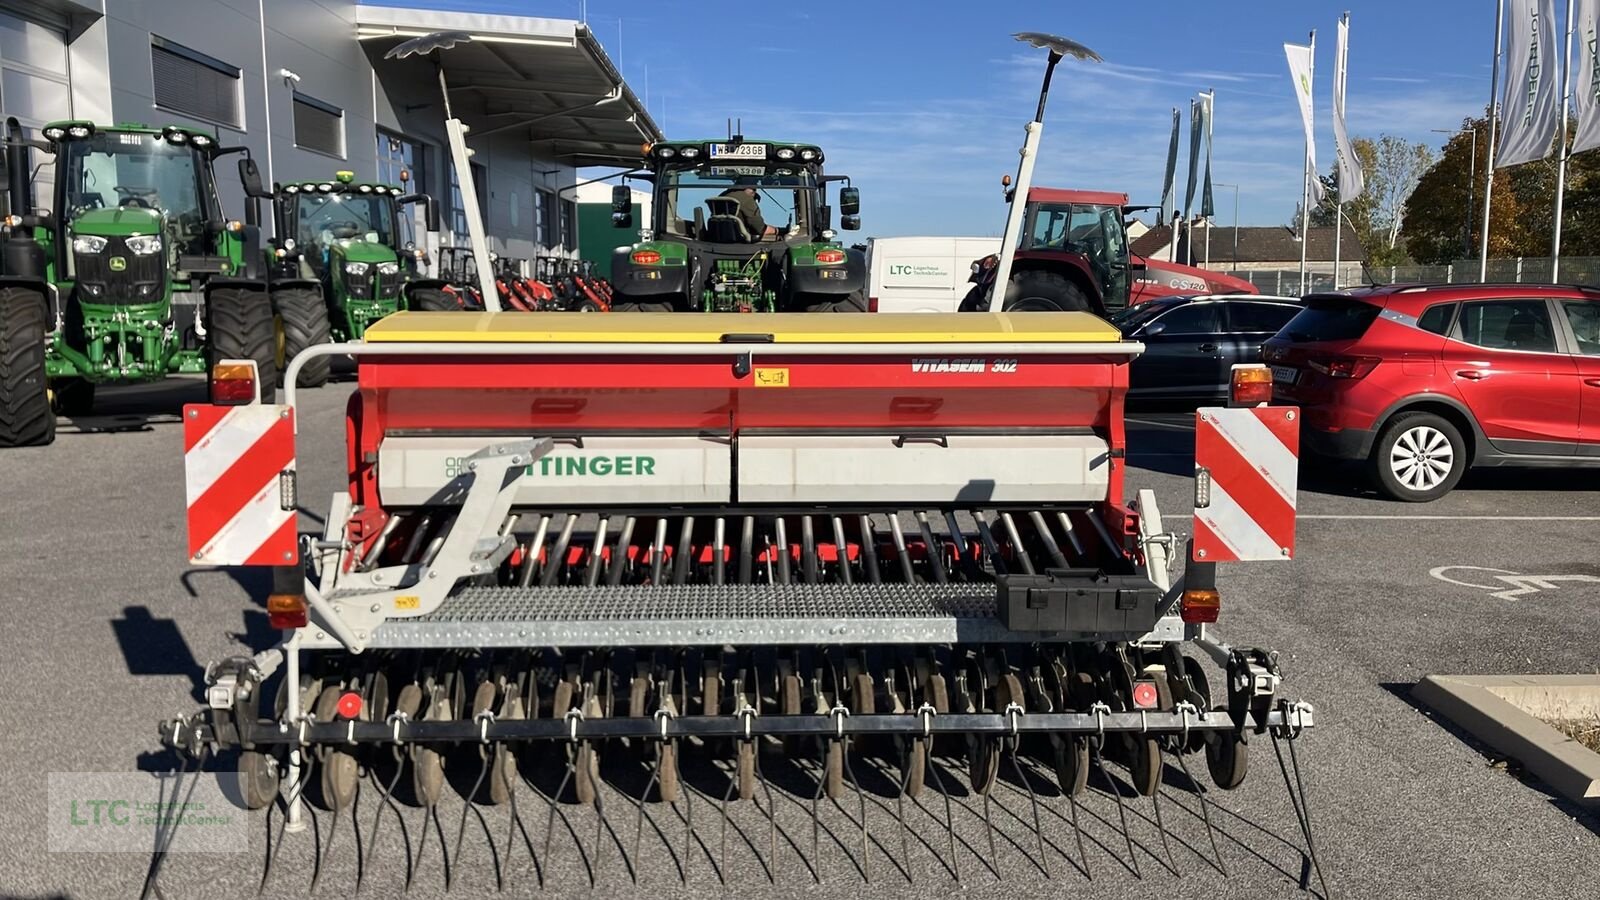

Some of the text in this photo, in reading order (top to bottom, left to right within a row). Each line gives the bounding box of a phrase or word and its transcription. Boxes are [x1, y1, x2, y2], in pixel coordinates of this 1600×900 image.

[1522, 8, 1540, 128] JOHN DEERE
[890, 265, 912, 275] LTC
[911, 358, 1018, 373] VITASEM 302
[525, 456, 656, 476] TINGER
